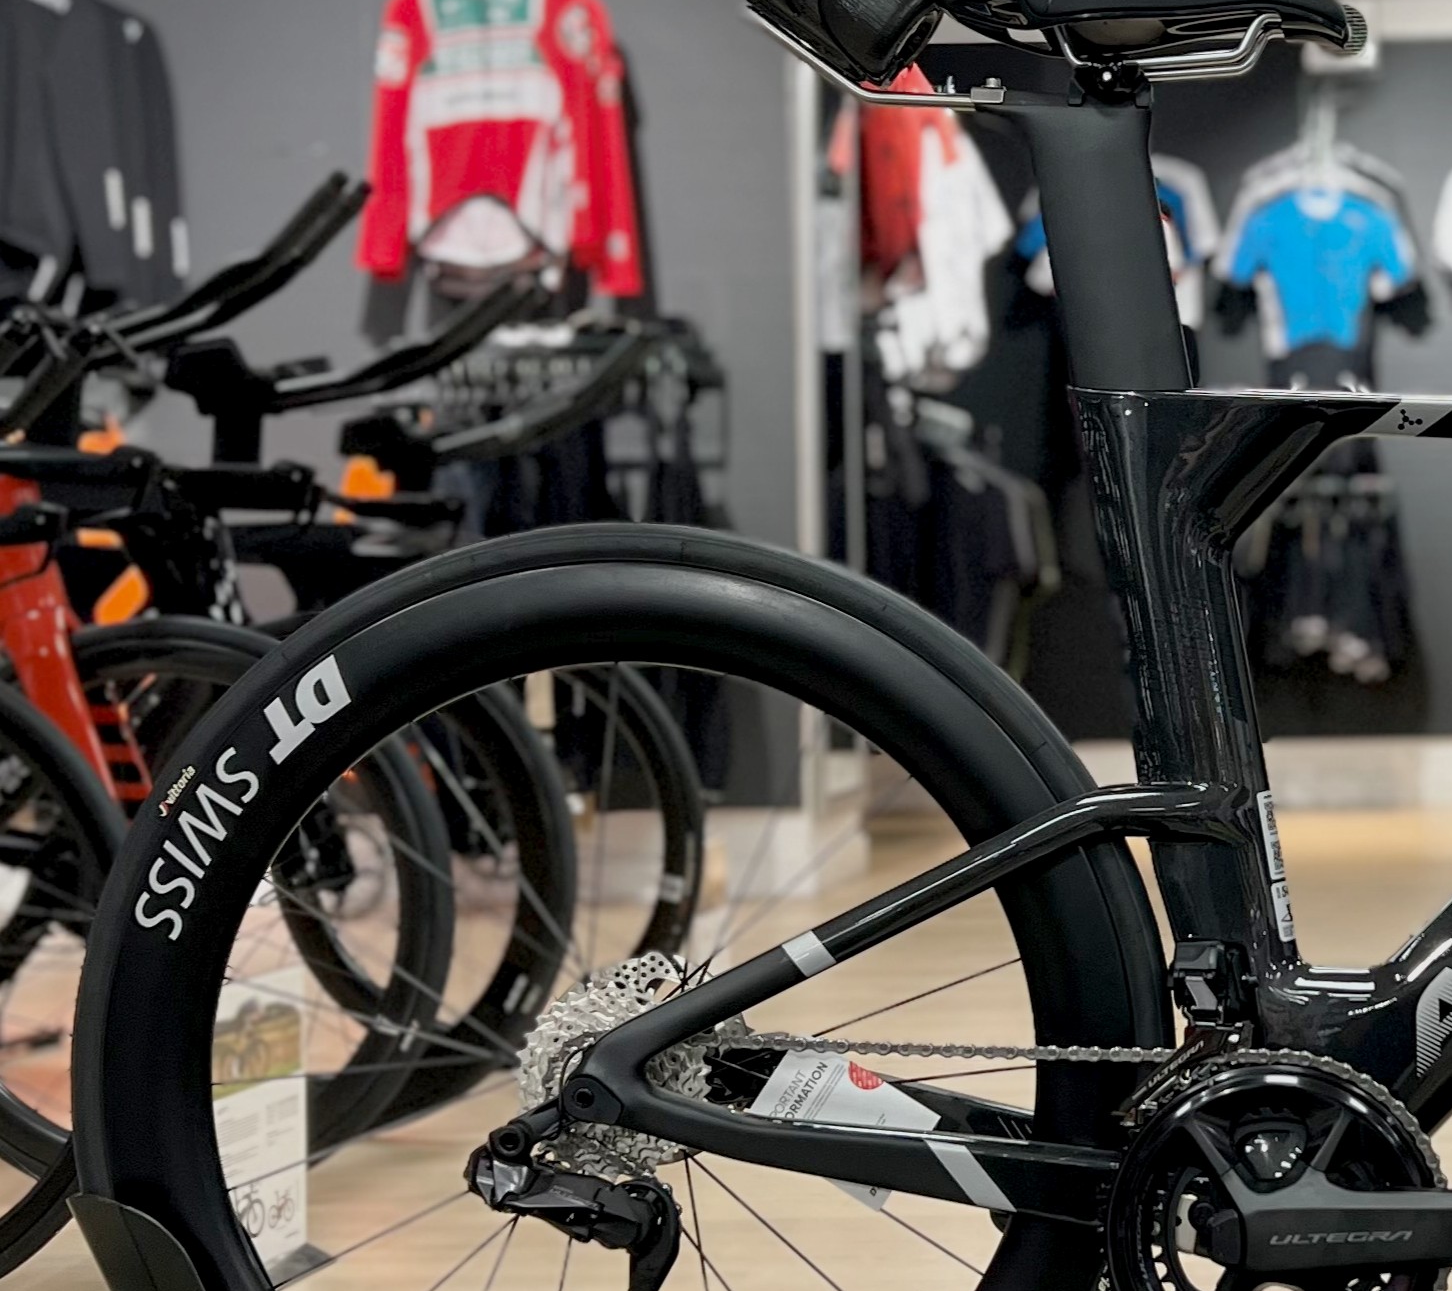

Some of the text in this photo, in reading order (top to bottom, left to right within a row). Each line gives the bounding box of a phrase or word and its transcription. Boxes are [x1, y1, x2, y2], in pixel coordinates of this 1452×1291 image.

[134, 654, 352, 941] DT SWISS
[1268, 1229, 1413, 1247] ULTEGRA
